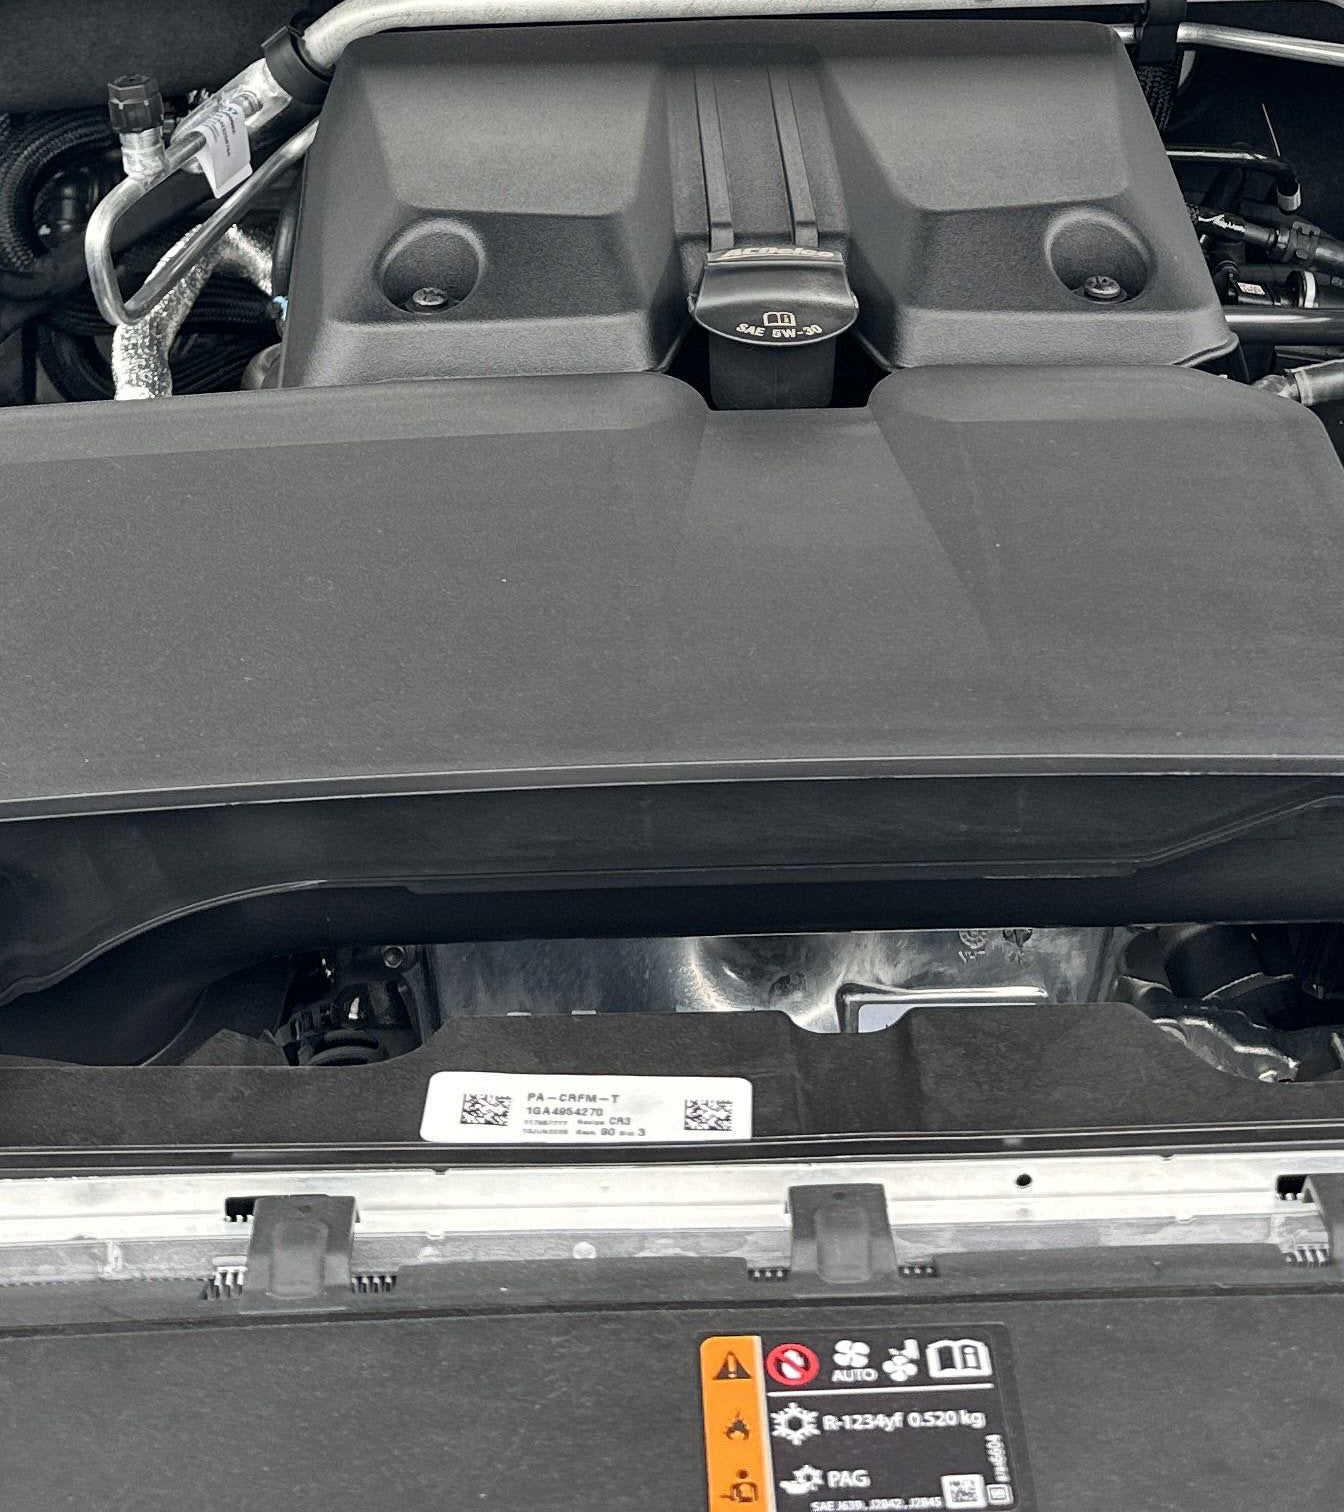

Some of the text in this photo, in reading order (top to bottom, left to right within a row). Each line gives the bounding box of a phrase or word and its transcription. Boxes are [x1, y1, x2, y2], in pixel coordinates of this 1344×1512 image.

[720, 247, 835, 259] ACDelco
[736, 323, 823, 338] SAE 5W-30
[600, 1127, 616, 1136] 90
[638, 1128, 646, 1137] 3
[831, 1368, 878, 1383] AUTO
[822, 1409, 987, 1432] R-1234yf 0.520 kg
[827, 1469, 871, 1488] PAG
[811, 1500, 834, 1511] SAE
